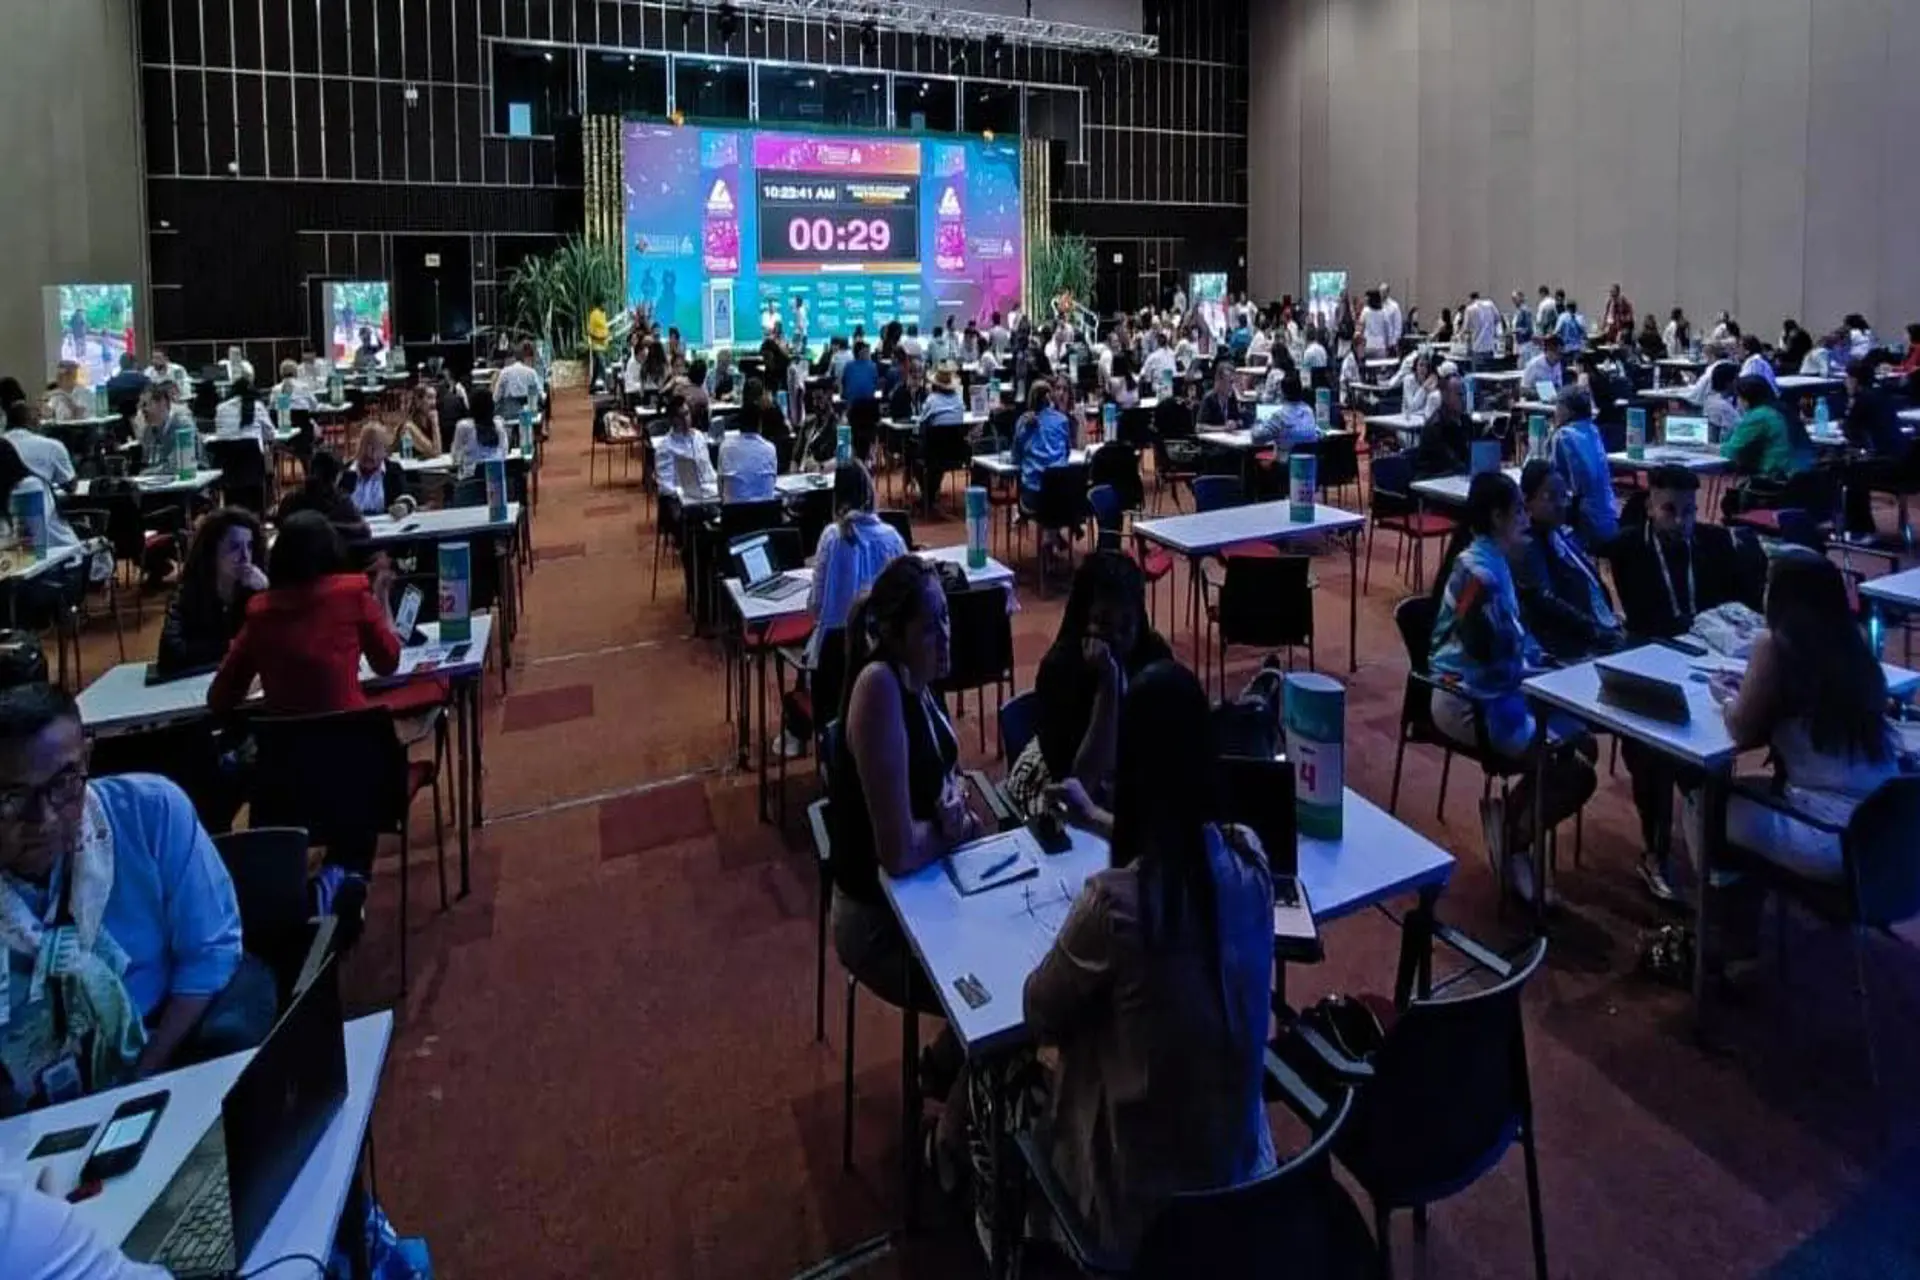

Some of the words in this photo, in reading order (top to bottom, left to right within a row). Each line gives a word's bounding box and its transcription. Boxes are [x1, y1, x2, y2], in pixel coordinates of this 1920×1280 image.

[815, 186, 836, 200] AM
[789, 218, 890, 251] 00:29
[1301, 762, 1315, 791] 4
